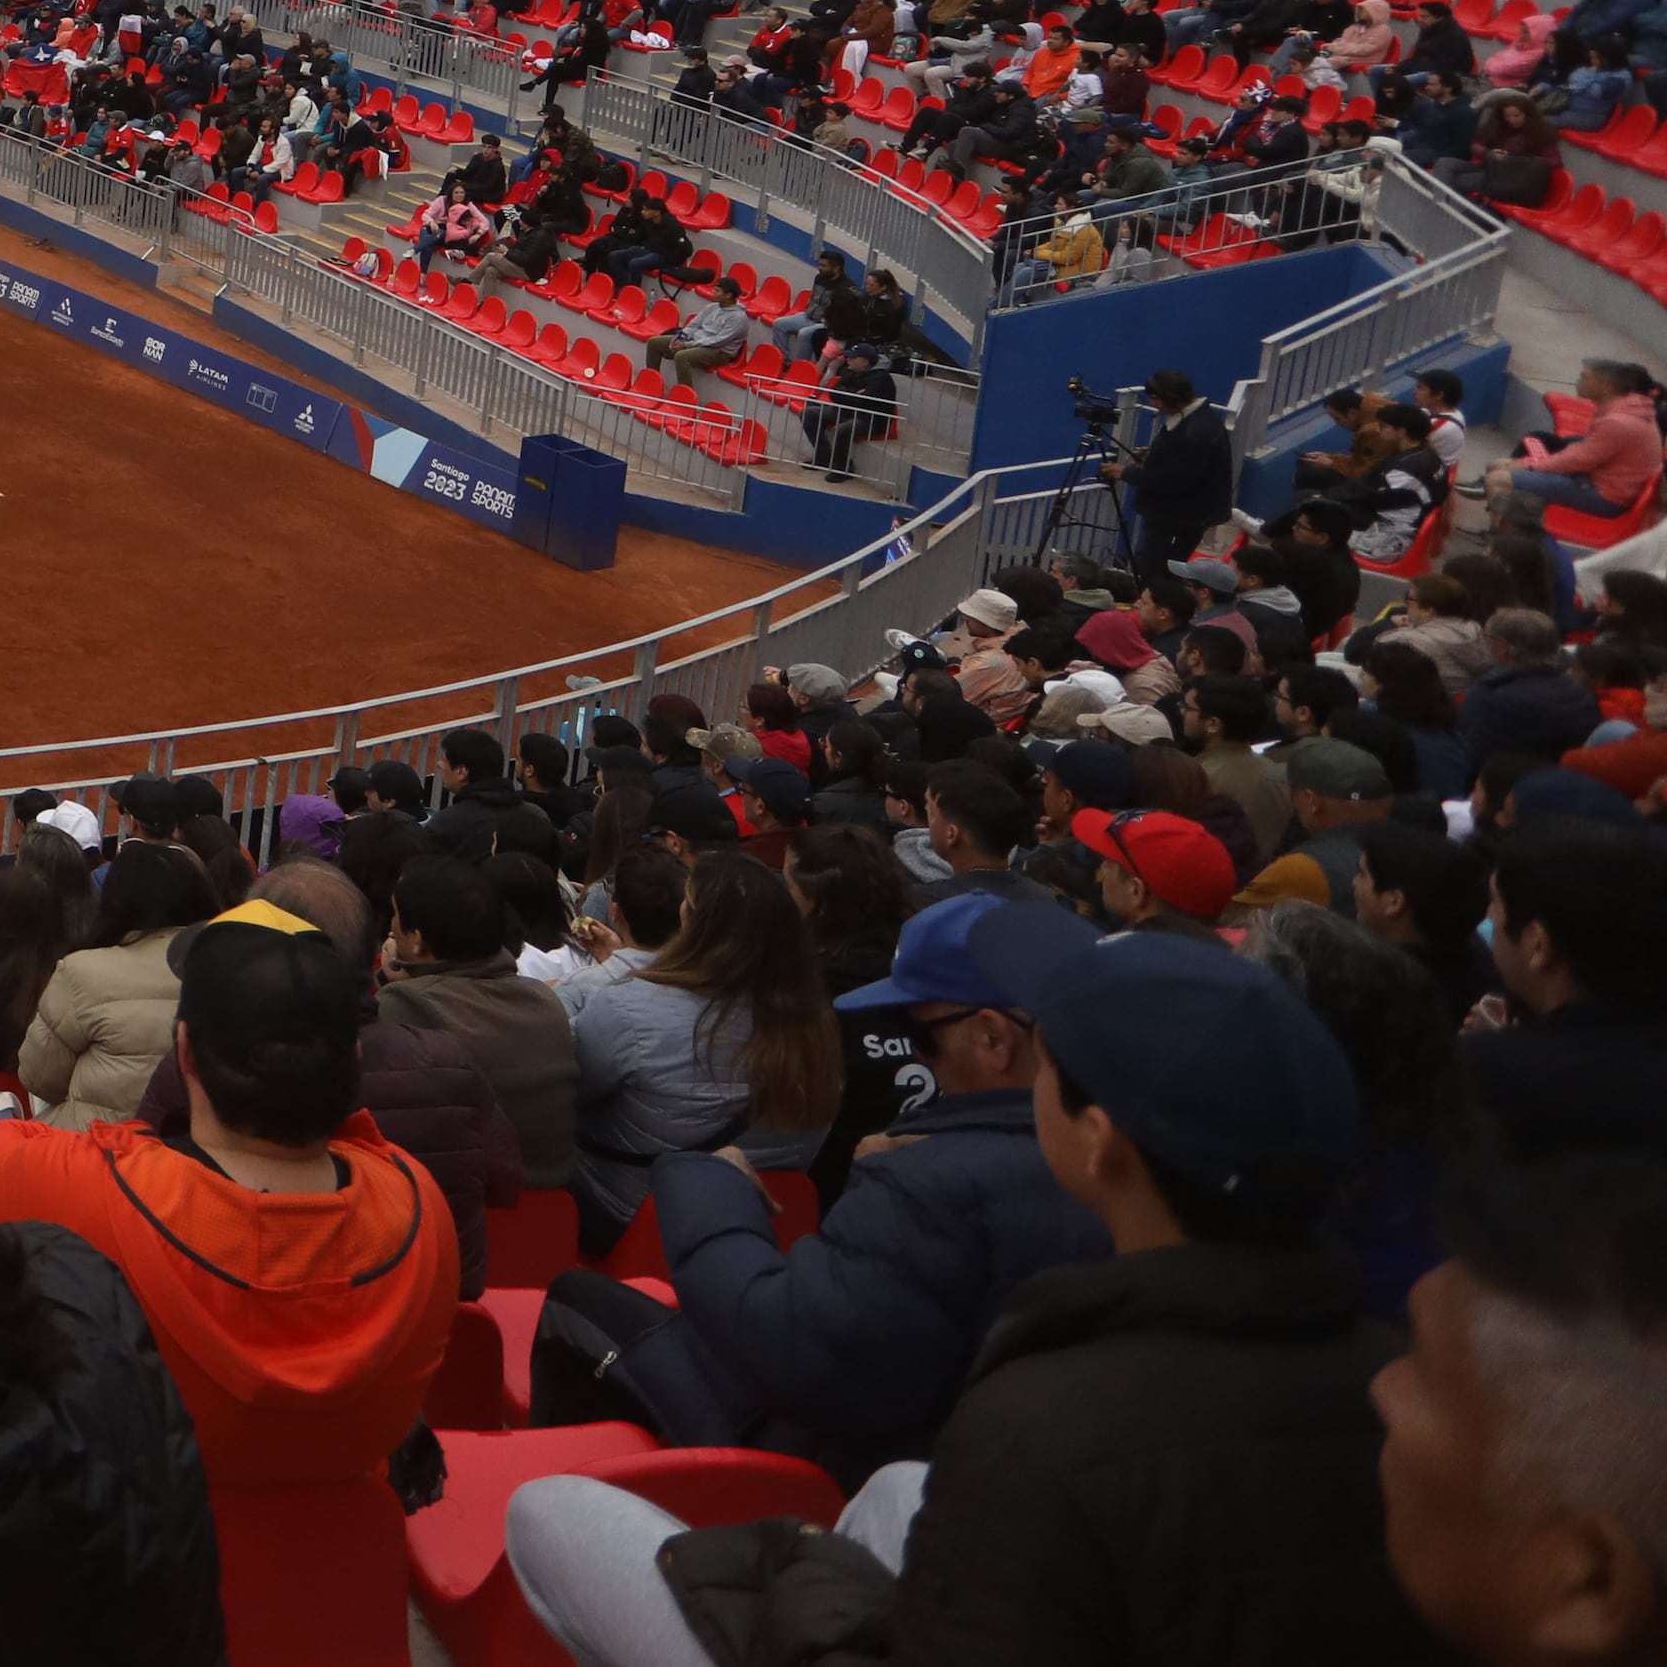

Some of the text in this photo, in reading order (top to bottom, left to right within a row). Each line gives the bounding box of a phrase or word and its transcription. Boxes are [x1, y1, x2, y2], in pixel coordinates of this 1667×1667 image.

[8, 290, 37, 309] SPORTS
[12, 281, 40, 300] PANAM
[142, 346, 164, 362] NAN
[145, 336, 166, 353] BOR
[198, 364, 229, 384] LATAM
[430, 458, 470, 482] Santiago
[423, 471, 467, 501] 2023
[470, 492, 515, 519] SPORTS
